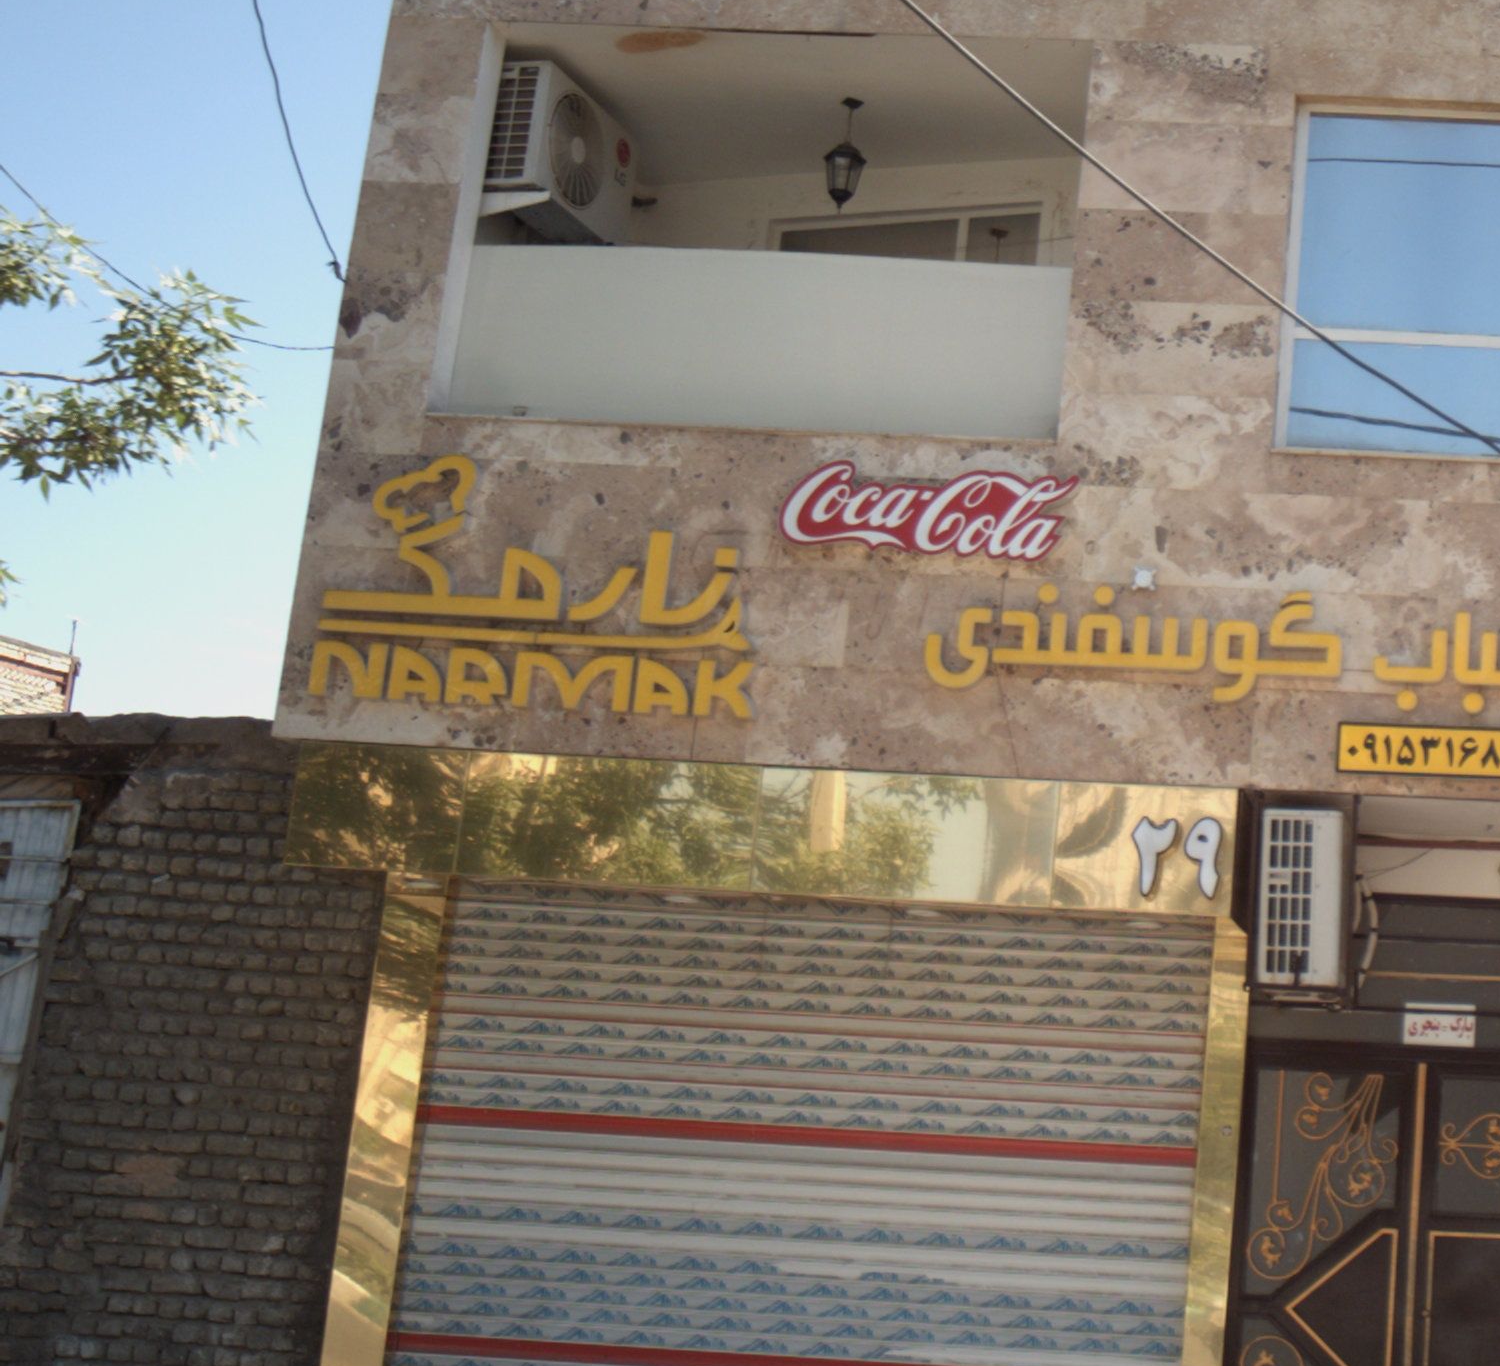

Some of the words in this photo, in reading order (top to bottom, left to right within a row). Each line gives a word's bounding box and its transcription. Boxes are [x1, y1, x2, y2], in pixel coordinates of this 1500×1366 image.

[322, 455, 741, 626] نارمک
[780, 460, 1078, 561] Coca-Cola
[308, 641, 756, 719] NARMAK
[924, 583, 1342, 703] گوسفندی
[1131, 816, 1223, 900] ۲۹
